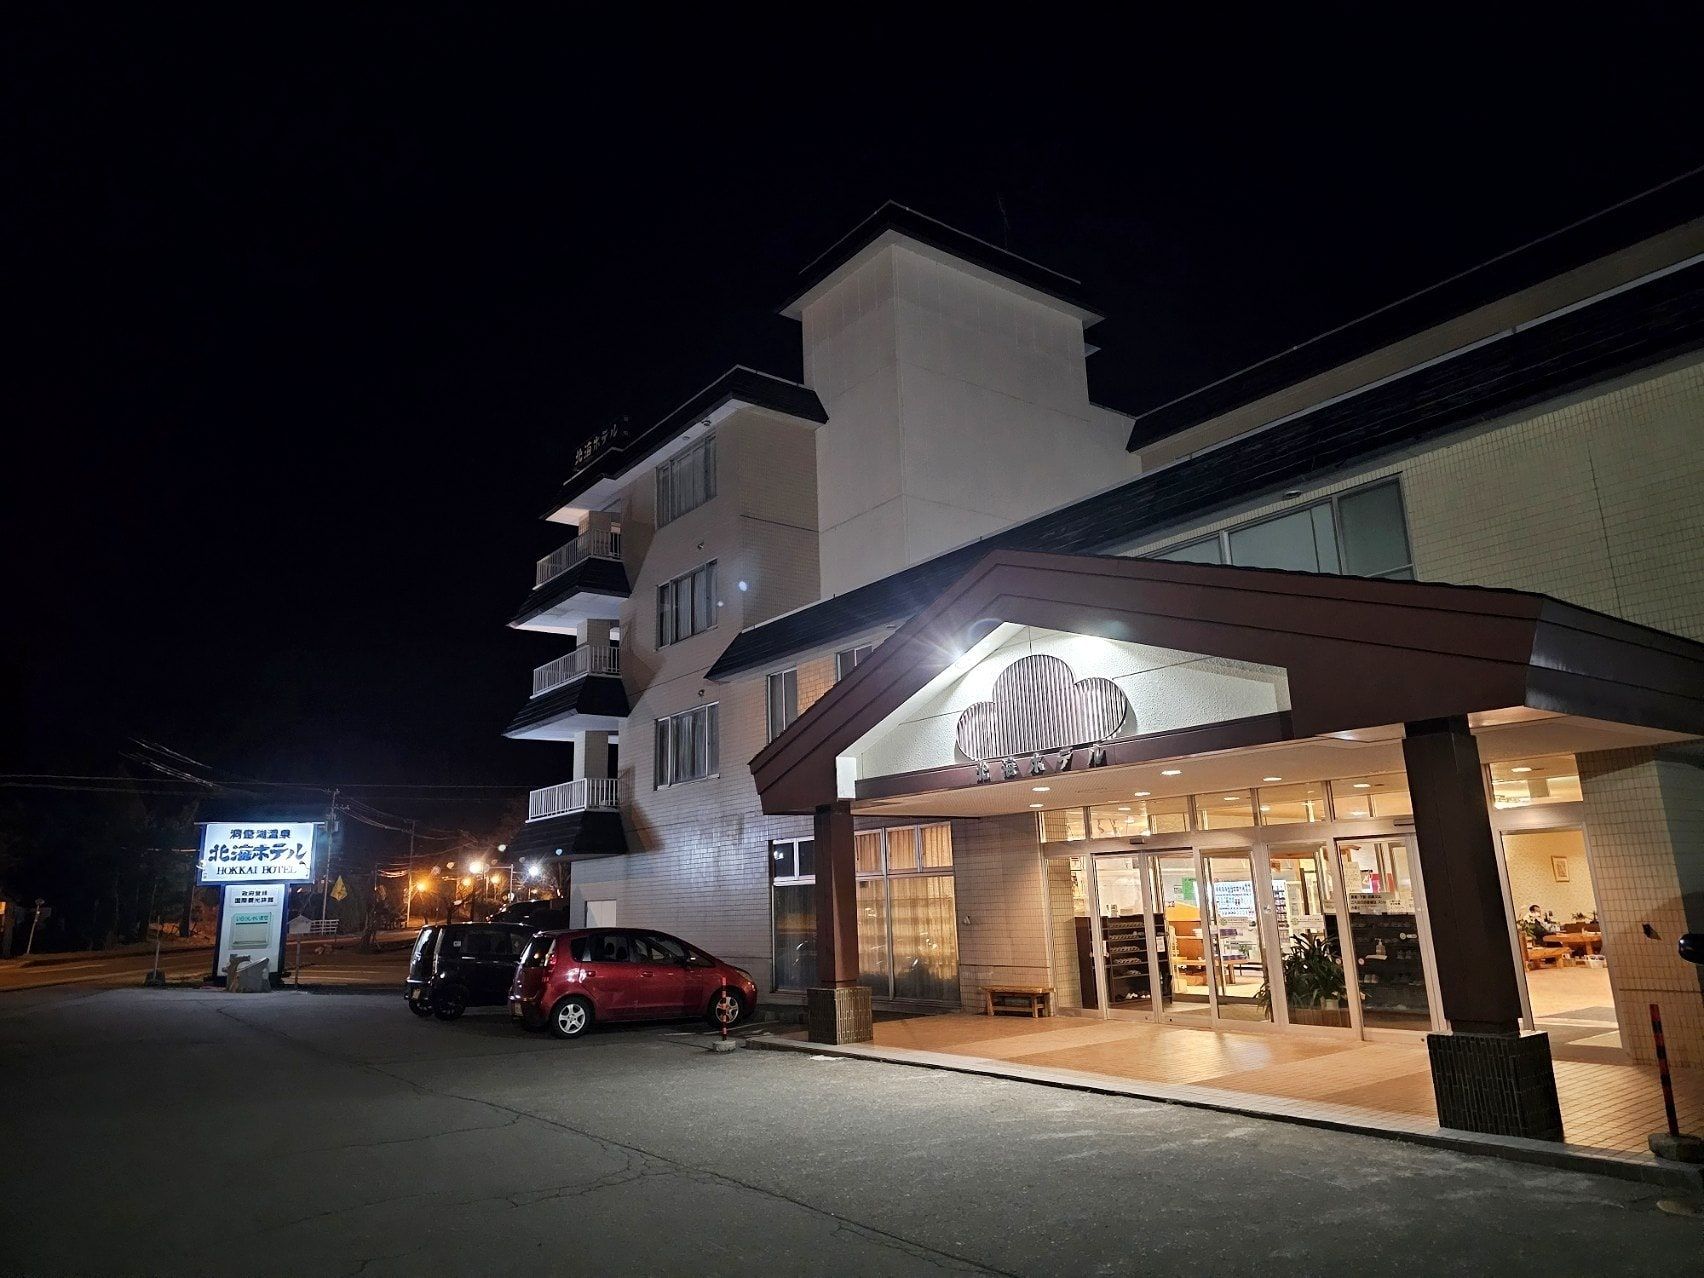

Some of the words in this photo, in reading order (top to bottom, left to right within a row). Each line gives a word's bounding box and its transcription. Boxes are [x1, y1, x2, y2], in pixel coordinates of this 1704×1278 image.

[208, 843, 307, 862] 北海ホテル
[217, 866, 258, 875] HOKKAI
[262, 865, 297, 875] HOTEL
